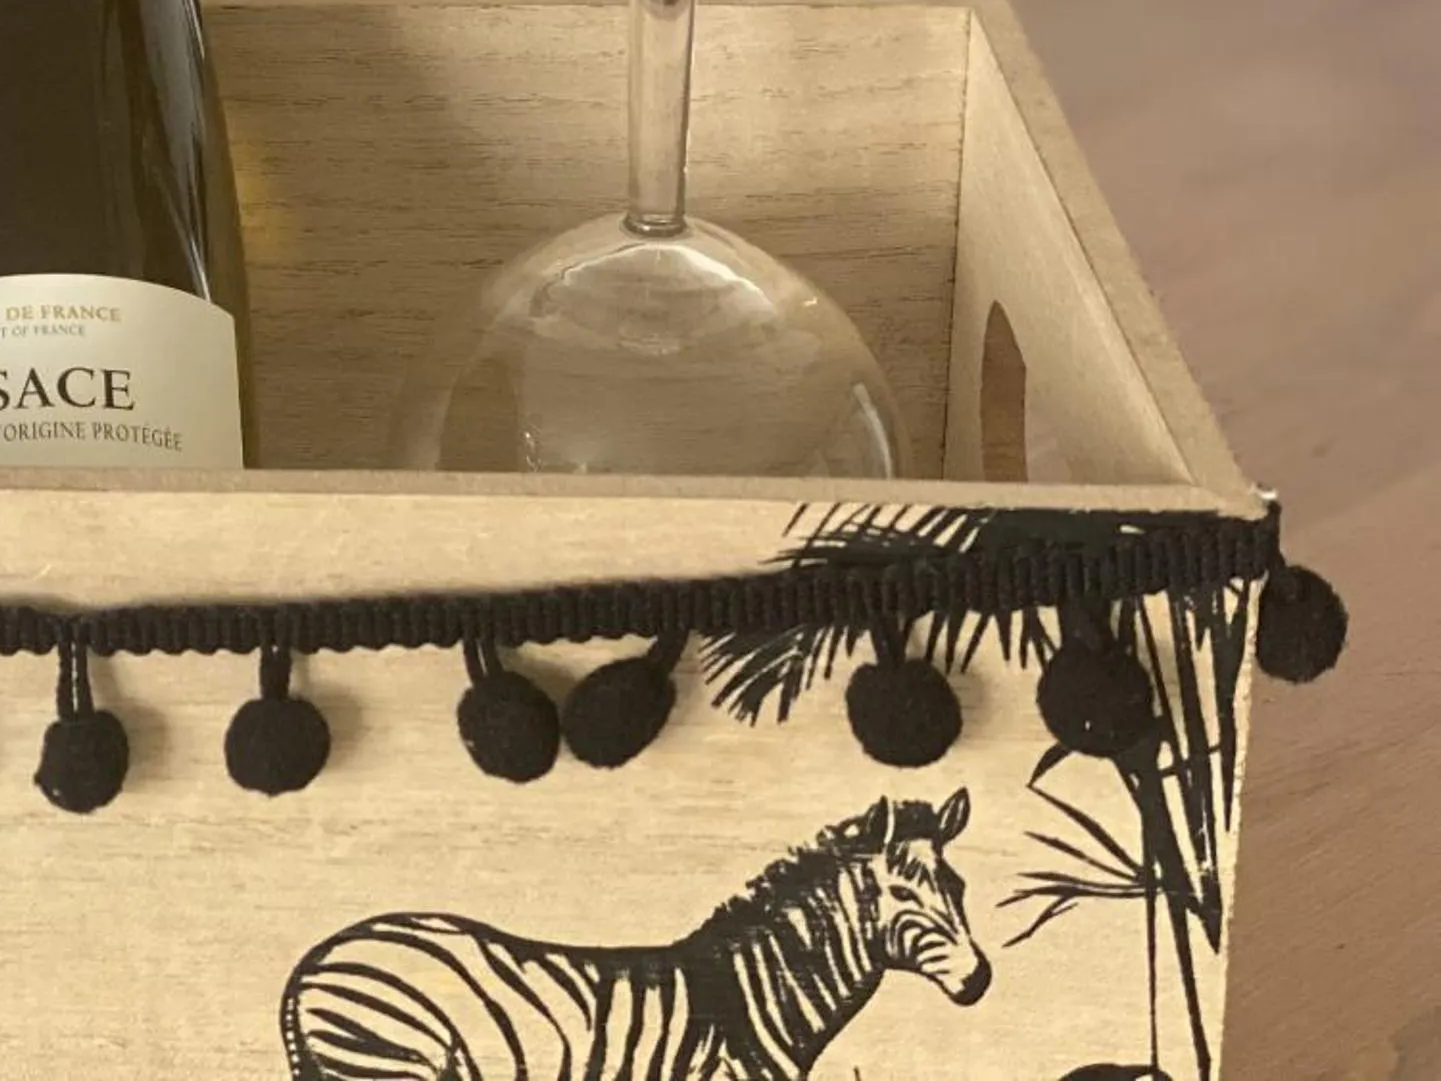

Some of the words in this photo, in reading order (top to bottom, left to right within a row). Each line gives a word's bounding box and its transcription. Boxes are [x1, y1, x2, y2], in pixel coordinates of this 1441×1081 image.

[6, 305, 34, 322] DE
[40, 304, 122, 323] FRANCE
[11, 324, 29, 338] OF
[33, 323, 86, 338] FRANCE
[92, 420, 184, 453] PROTÉGÉE
